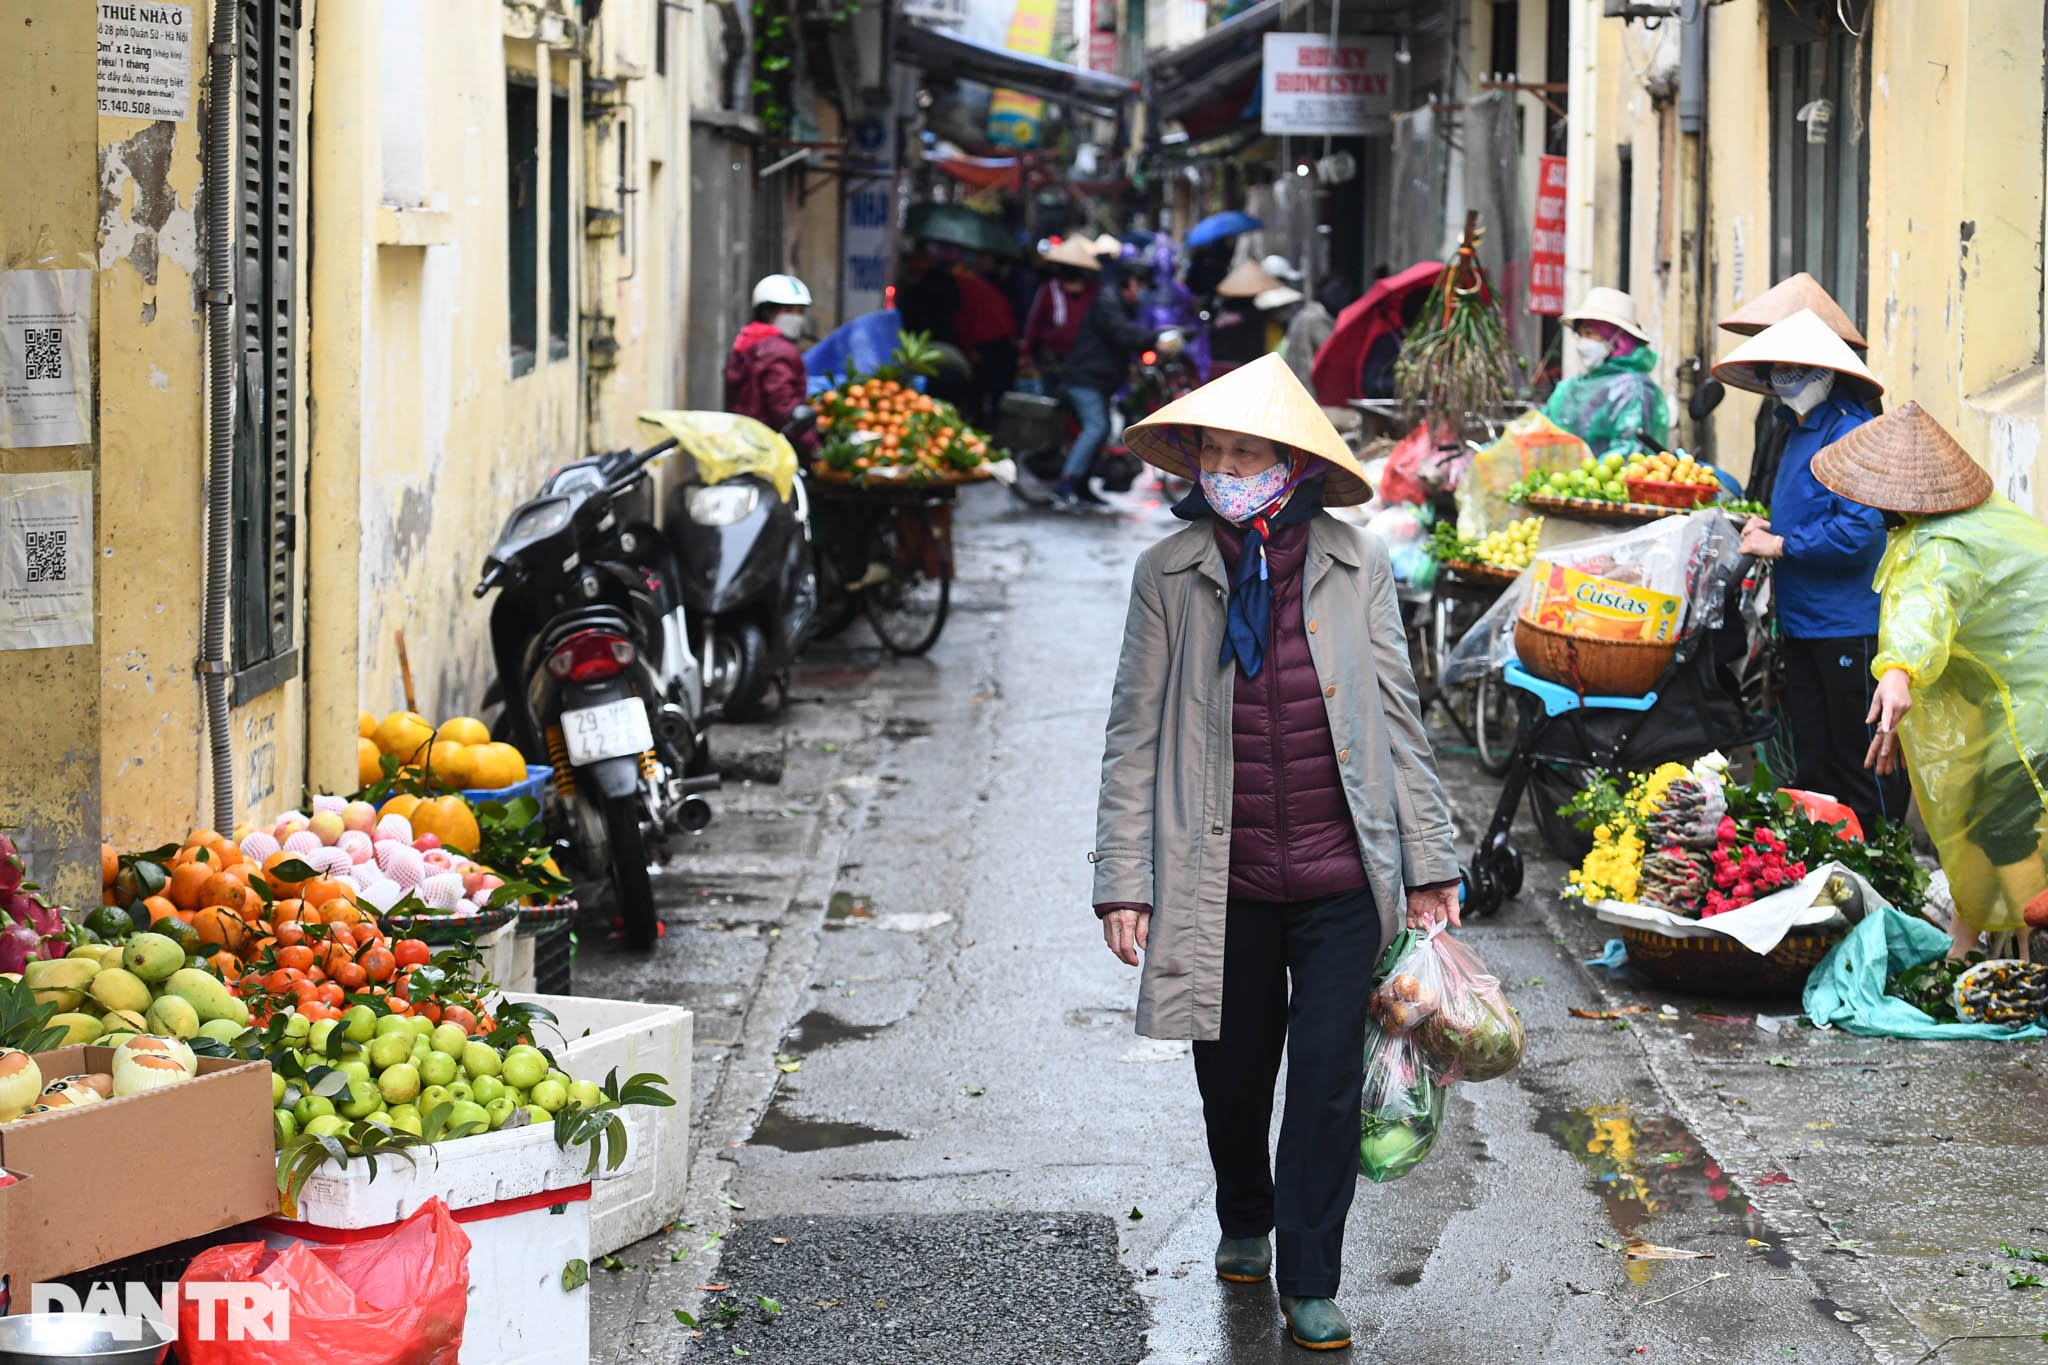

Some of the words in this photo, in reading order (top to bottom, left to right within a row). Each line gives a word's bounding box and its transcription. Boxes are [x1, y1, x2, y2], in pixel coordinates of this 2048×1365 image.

[102, 4, 136, 21] THUÊ
[140, 8, 169, 24] NHÀ
[172, 8, 182, 25] Ở
[105, 25, 113, 35] 28
[116, 45, 122, 53] x
[124, 44, 130, 54] 2
[120, 58, 123, 67] 1
[1576, 582, 1649, 616] Custas
